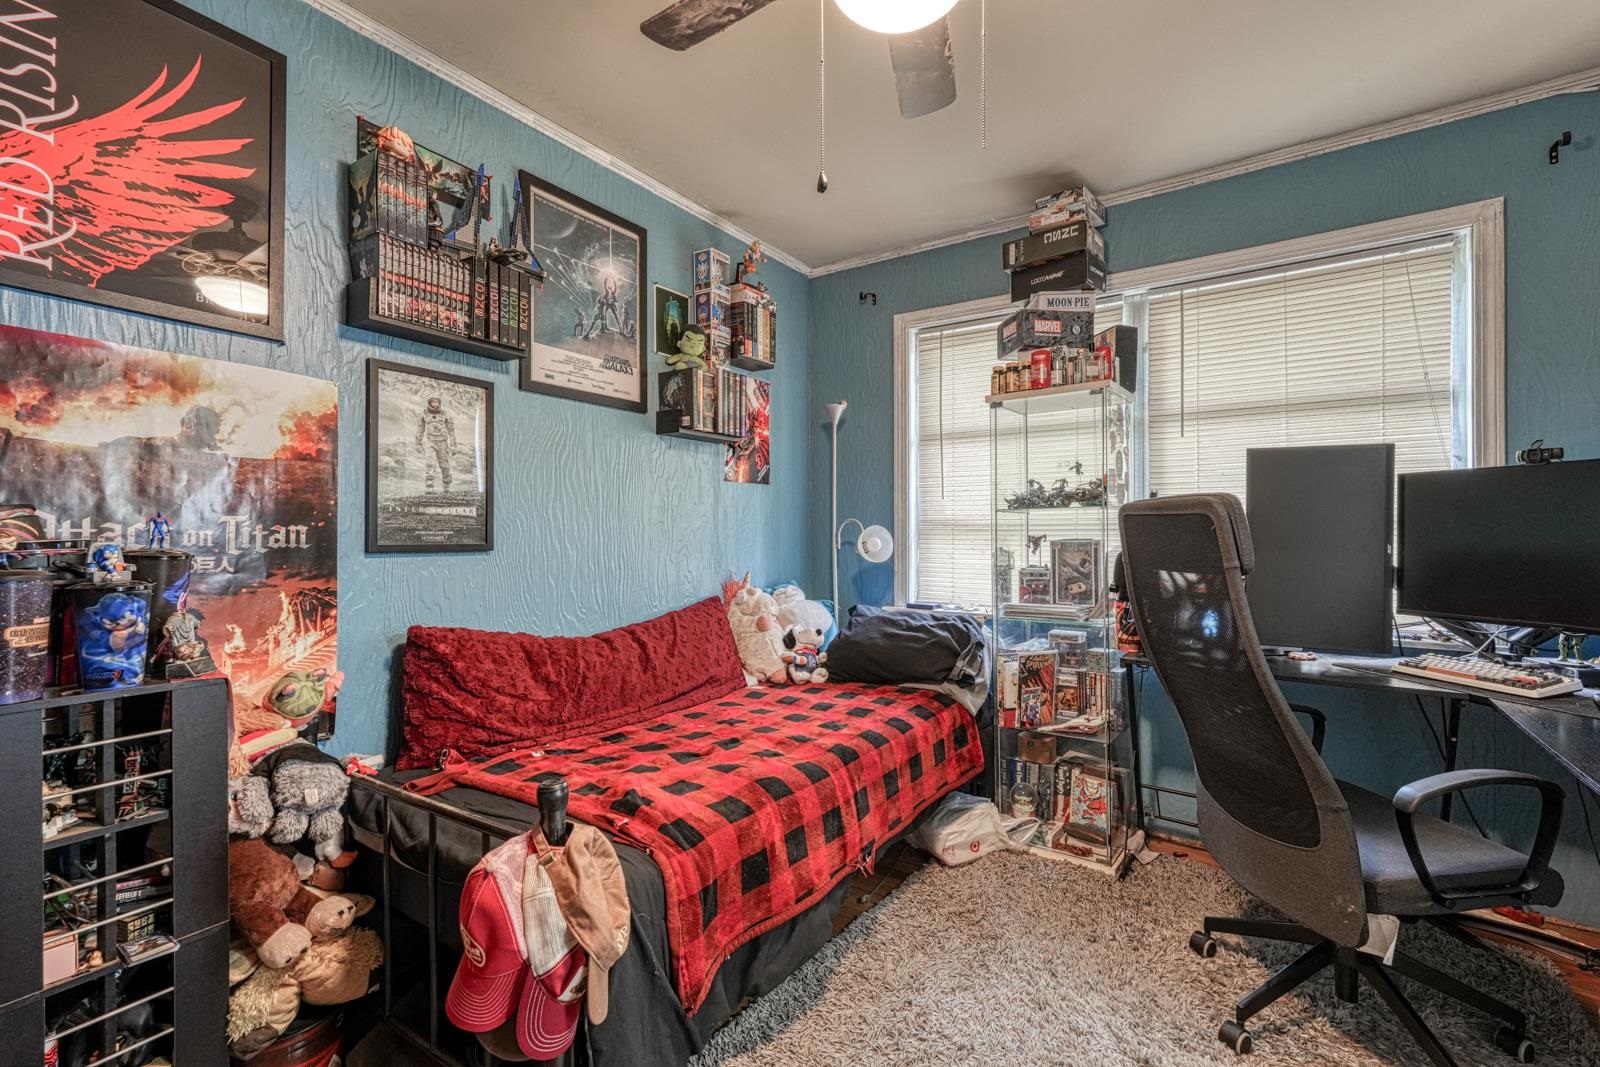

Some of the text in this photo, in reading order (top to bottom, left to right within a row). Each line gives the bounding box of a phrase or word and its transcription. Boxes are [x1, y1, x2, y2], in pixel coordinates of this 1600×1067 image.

[0, 0, 79, 271] RED RISIN
[1043, 225, 1080, 244] UNSC
[1047, 297, 1090, 308] MOON PIE
[1035, 320, 1062, 333] MARVEL
[388, 506, 474, 514] INTERSTELLAR
[36, 509, 312, 555] Attac on Titan
[116, 891, 137, 901] LEFIELD
